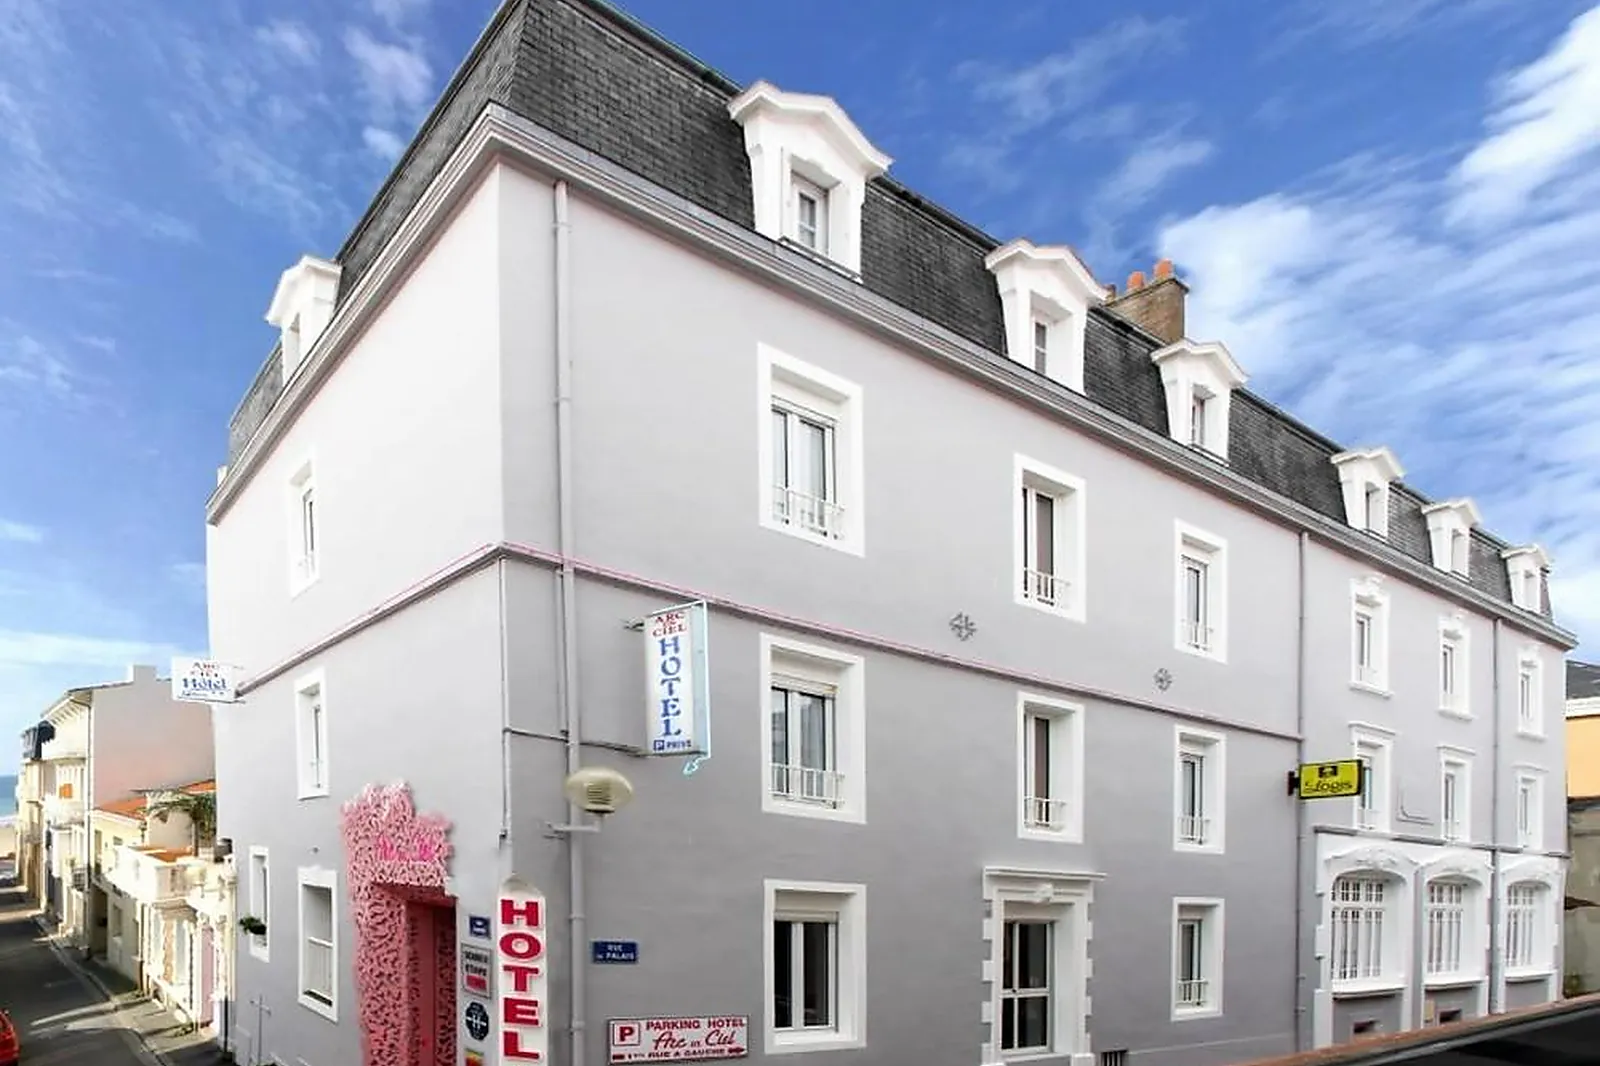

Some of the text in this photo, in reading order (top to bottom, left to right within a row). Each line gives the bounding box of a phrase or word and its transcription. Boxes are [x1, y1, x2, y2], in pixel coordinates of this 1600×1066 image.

[655, 611, 685, 623] ARC
[652, 624, 688, 636] CIEL
[658, 636, 682, 736] HOTEL
[607, 944, 623, 952] RUE
[499, 899, 541, 1060] HOTEL
[646, 1017, 745, 1030] PARKING HOTEL
[619, 1026, 634, 1042] P
[652, 1031, 688, 1050] Arc
